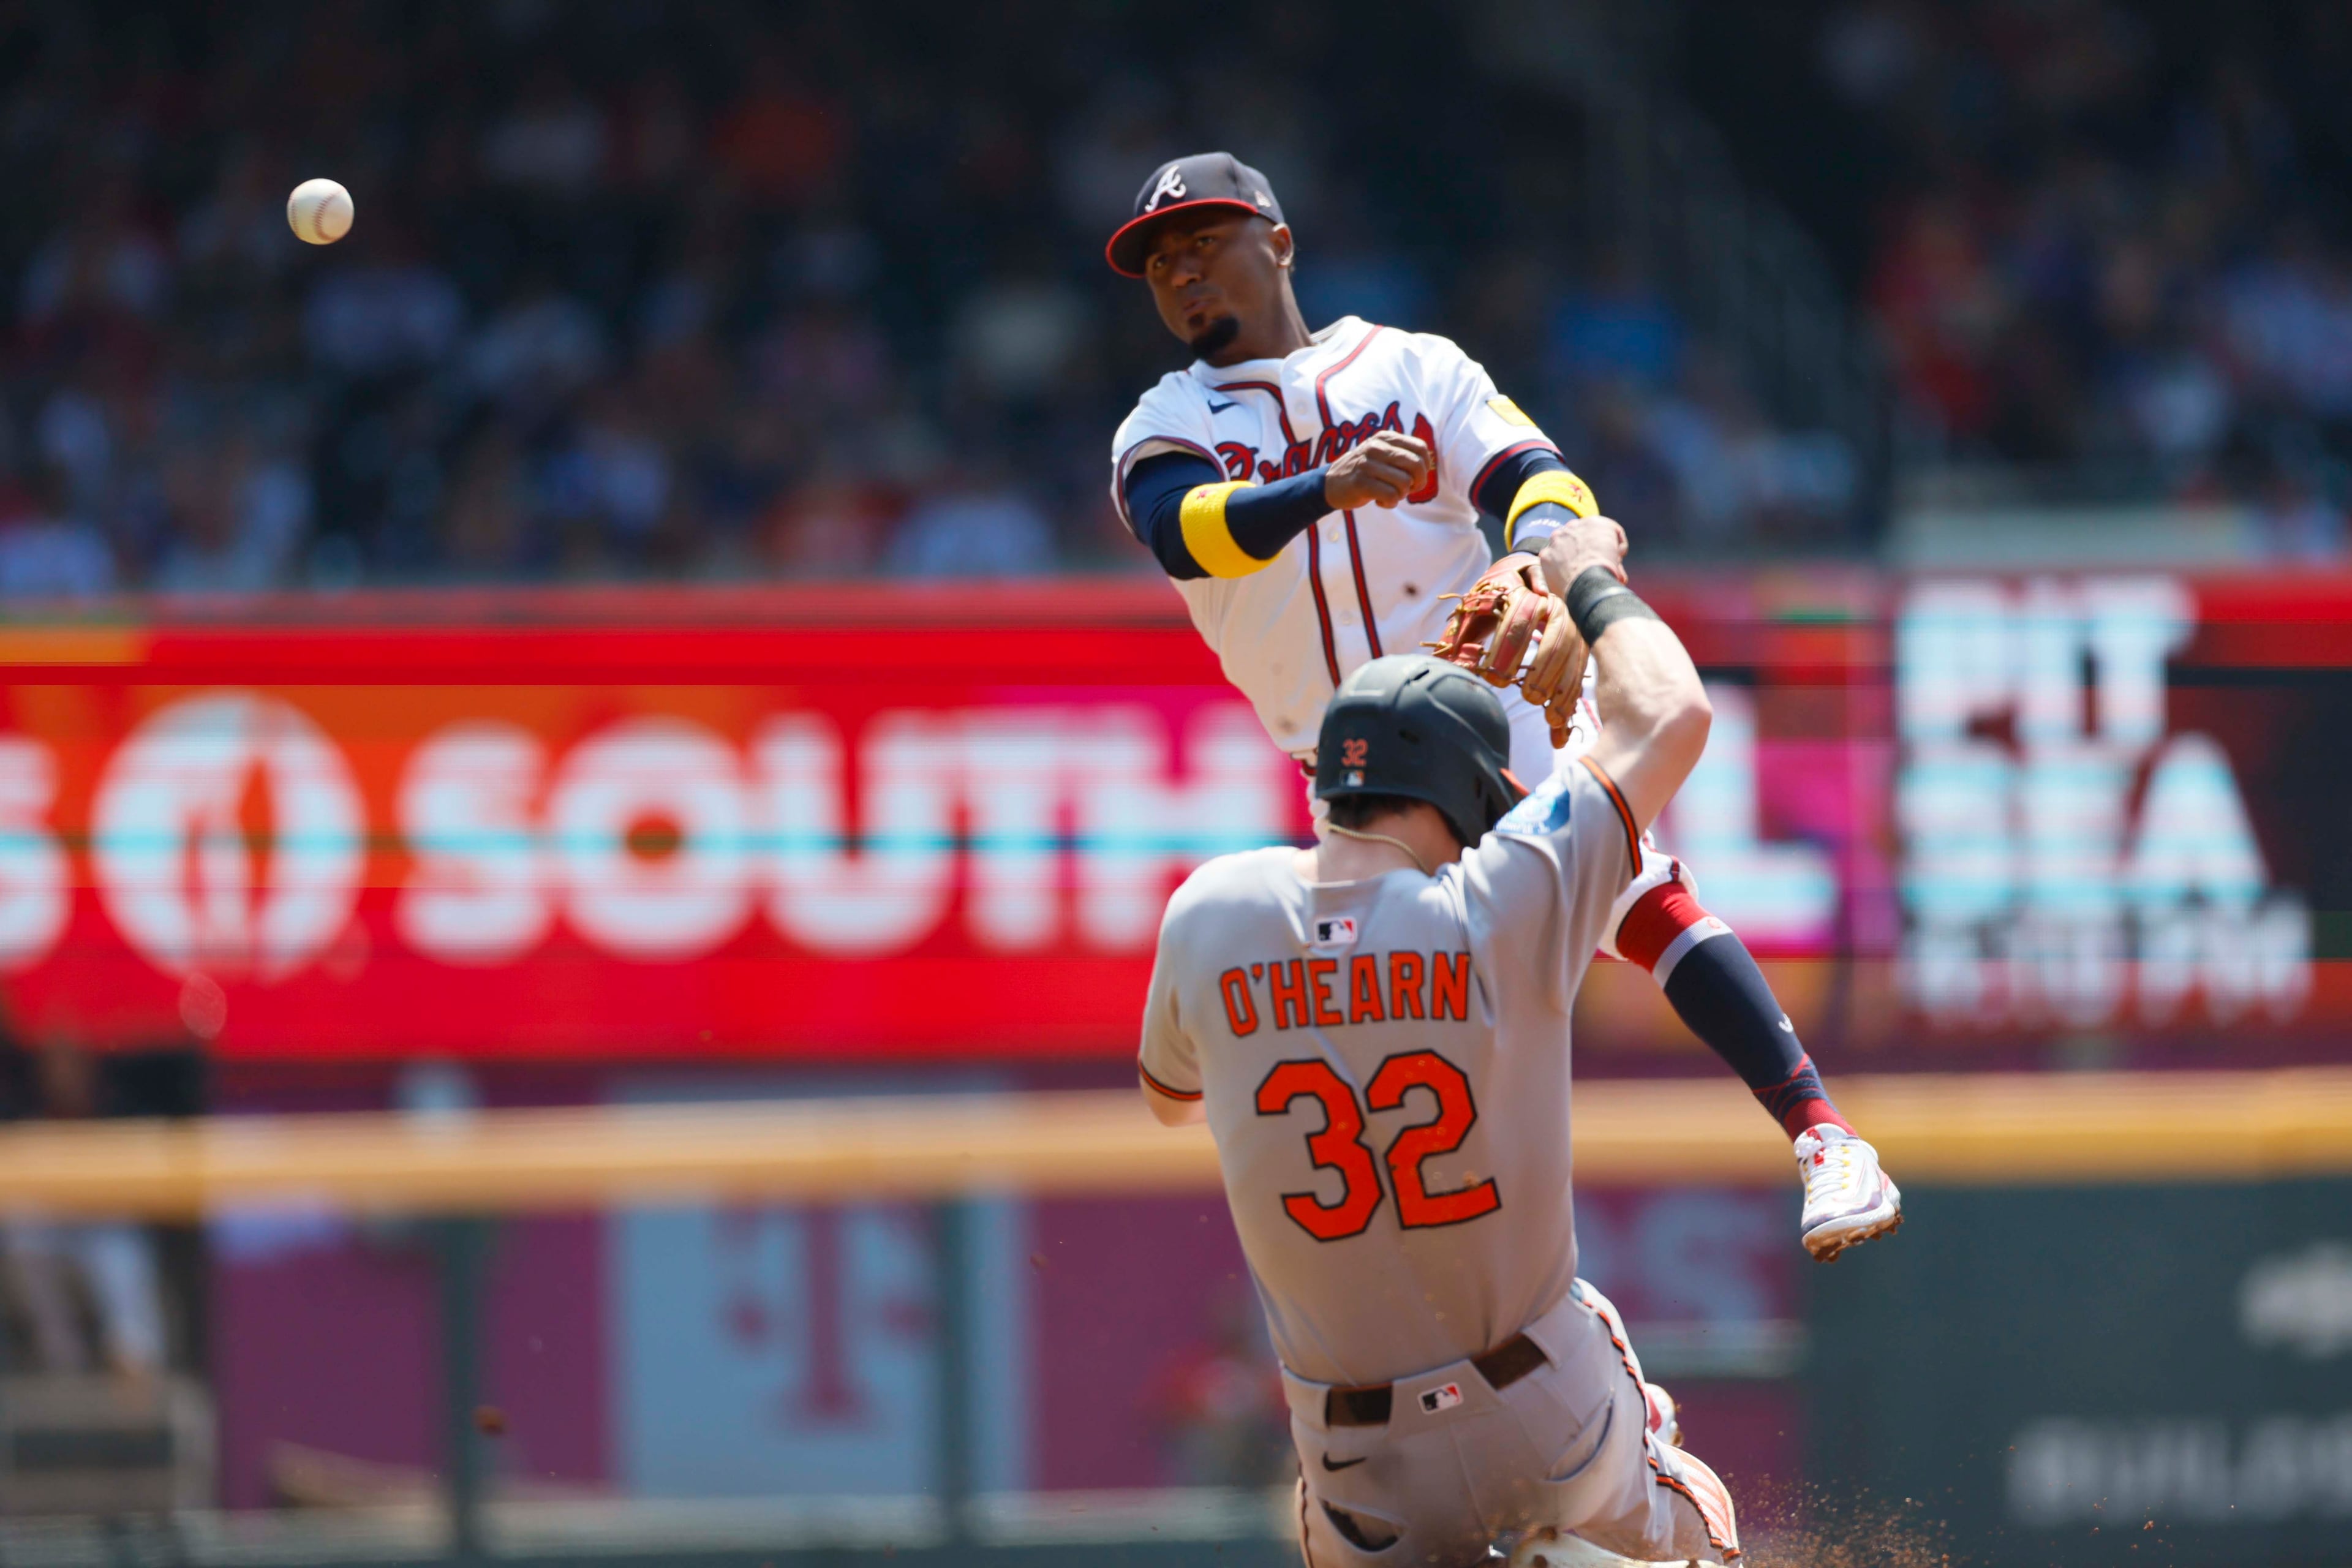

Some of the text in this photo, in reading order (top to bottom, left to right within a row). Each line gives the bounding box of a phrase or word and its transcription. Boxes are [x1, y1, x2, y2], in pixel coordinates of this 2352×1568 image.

[1144, 164, 1187, 213] A
[1341, 739, 1369, 766] 32
[398, 714, 1291, 962] SOUTH
[1220, 951, 1471, 1038] O'HEARN
[1255, 1048, 1502, 1243] 32
